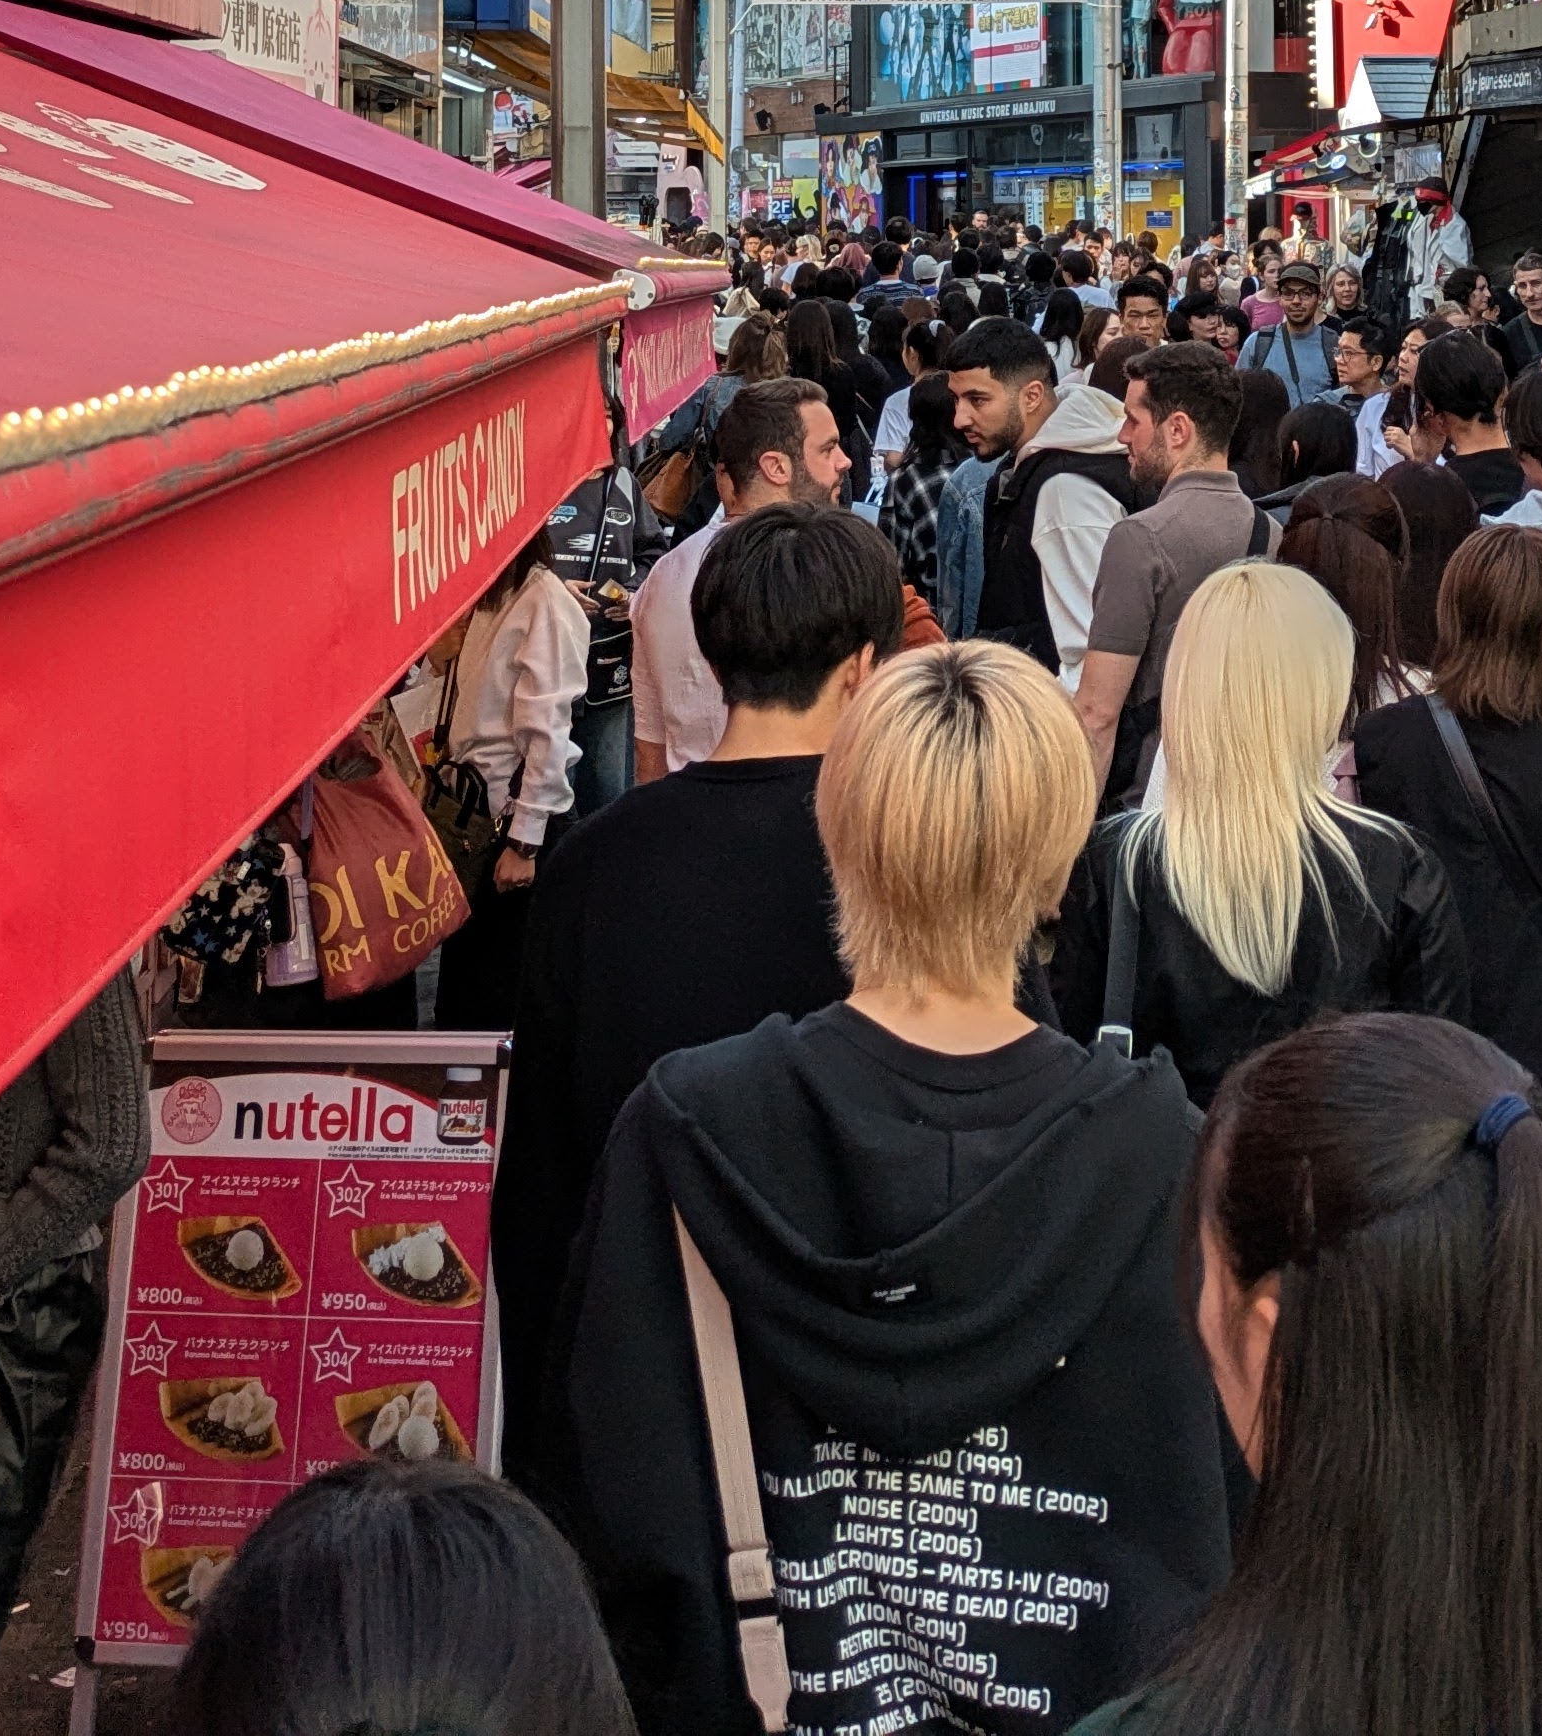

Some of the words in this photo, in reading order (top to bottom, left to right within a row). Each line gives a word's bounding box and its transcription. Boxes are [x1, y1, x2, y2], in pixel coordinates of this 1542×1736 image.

[261, 5, 302, 65] 原宿店
[920, 110, 960, 124] UNIVERSAL
[961, 107, 984, 121] MUSIC
[986, 104, 1010, 119] STORE
[1012, 100, 1056, 116] HARAJUKU
[772, 200, 790, 213] 2F
[393, 432, 471, 625] FRUITS
[472, 399, 526, 549] CANDY
[375, 833, 454, 919] KA
[392, 880, 458, 953] COFFEE
[234, 1087, 413, 1143] nutella
[441, 1098, 485, 1115] nutella
[154, 1182, 179, 1199] 301
[201, 1175, 301, 1189] アイスヌテラクランチ
[380, 1178, 492, 1194] アイスヌテラホイップクランチ
[335, 1187, 362, 1204] 302
[137, 1287, 182, 1305] ¥800
[321, 1292, 367, 1311] ¥950
[137, 1345, 163, 1361] 303
[184, 1337, 291, 1352] バナナヌテラクランチ
[367, 1343, 474, 1358] アイスバナナヌテラクランチ
[321, 1351, 347, 1368] 304
[119, 1452, 165, 1471] ¥800
[814, 1442, 857, 1463] TAKE
[957, 1450, 1022, 1482] (1999)
[783, 1473, 816, 1498] ALL
[816, 1468, 858, 1492] LOOK
[865, 1470, 903, 1492] THE
[908, 1472, 965, 1500] SAME
[971, 1481, 996, 1504] TO
[1001, 1486, 1032, 1507] ME
[1036, 1486, 1109, 1524] (2002)
[843, 1495, 903, 1520] NOISE
[909, 1499, 978, 1534] (2004)
[835, 1522, 904, 1549] LIGHTS
[910, 1528, 982, 1563] (2006)
[837, 1549, 919, 1579] CROWDS
[939, 1563, 1003, 1590] PARTS
[1009, 1569, 1042, 1593] I-IV
[1046, 1572, 1110, 1609] (2009)
[878, 1581, 949, 1612] YOU'RE
[955, 1594, 1008, 1619] DEAD
[1014, 1598, 1078, 1632] (2012)
[103, 1620, 149, 1641] ¥950
[847, 1602, 902, 1626] AXIOM
[906, 1612, 967, 1647] (2014)
[934, 1645, 998, 1680] (2015)
[792, 1669, 827, 1693] THE
[870, 1653, 979, 1701] FOUNDATION
[984, 1681, 1051, 1715] (2016)
[875, 1682, 893, 1706] 25
[868, 1708, 906, 1736] ARMS
[905, 1705, 919, 1725] &
